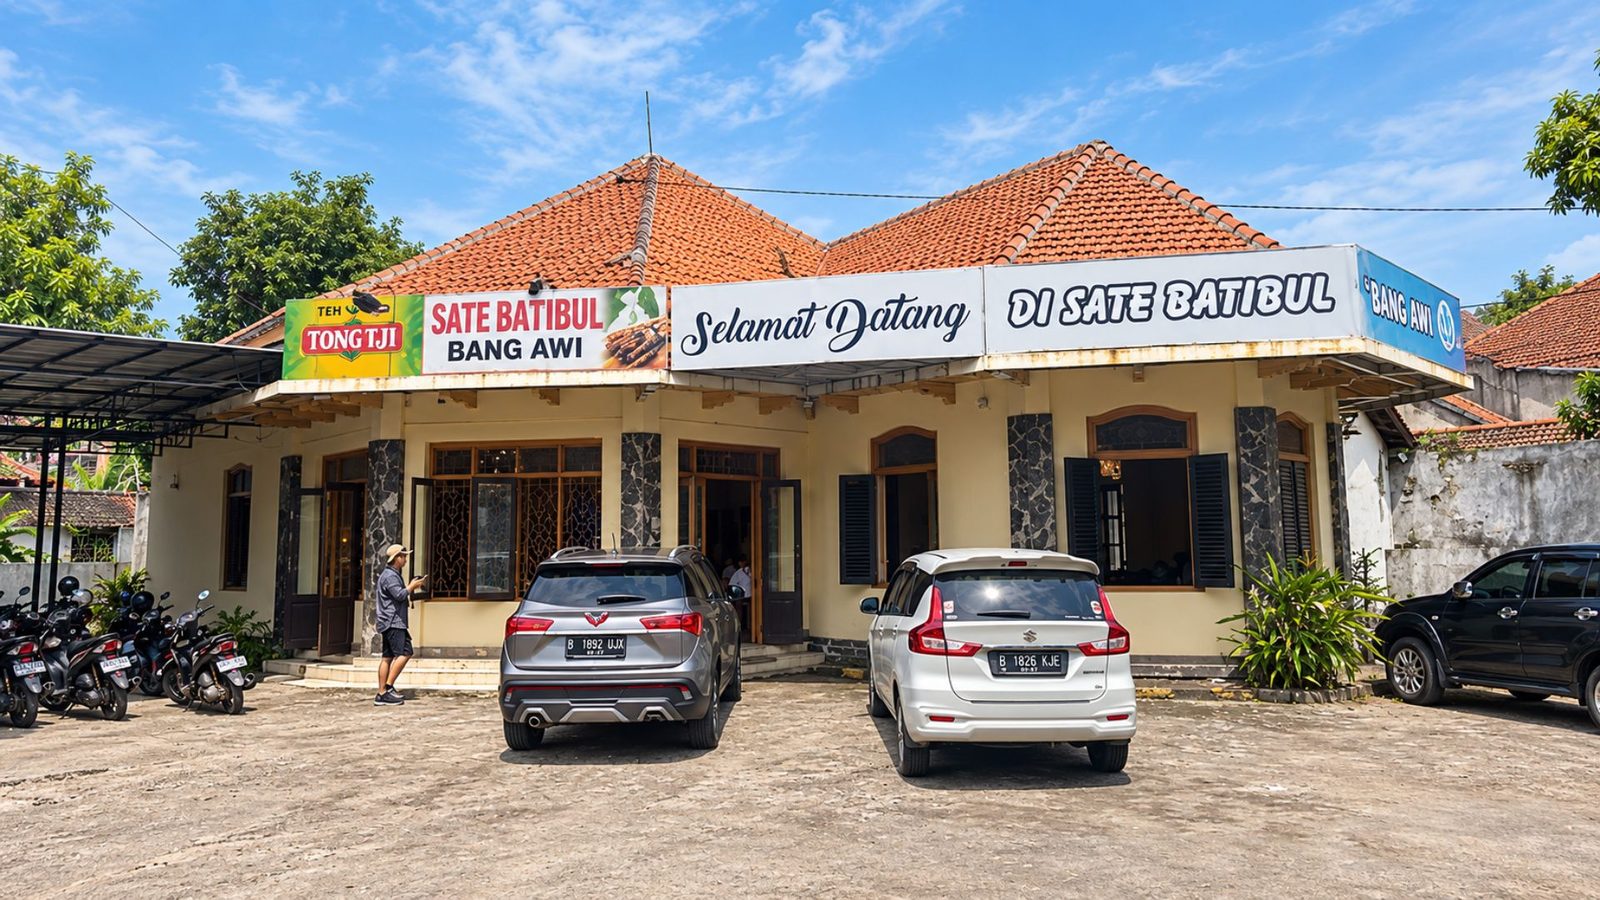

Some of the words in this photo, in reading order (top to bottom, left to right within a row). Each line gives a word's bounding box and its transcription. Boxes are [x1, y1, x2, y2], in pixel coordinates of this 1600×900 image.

[317, 305, 342, 318] TEH
[1007, 287, 1056, 329] DI
[1059, 281, 1158, 326] SATE
[1162, 272, 1337, 323] BATIBUL
[431, 300, 491, 335] SATE
[496, 297, 604, 333] BATIBUL
[680, 301, 828, 357] Selamat
[825, 292, 971, 353] Datang
[1410, 297, 1435, 338] AWI
[307, 328, 363, 351] TONG
[364, 326, 397, 349] TJI
[447, 338, 522, 362] BANG
[530, 336, 583, 360] AWI
[567, 638, 574, 650] B
[582, 638, 603, 650] 1892
[607, 638, 624, 649] UJX
[999, 655, 1006, 667] B
[1013, 655, 1037, 667] 1826
[1041, 655, 1061, 667] KJE
